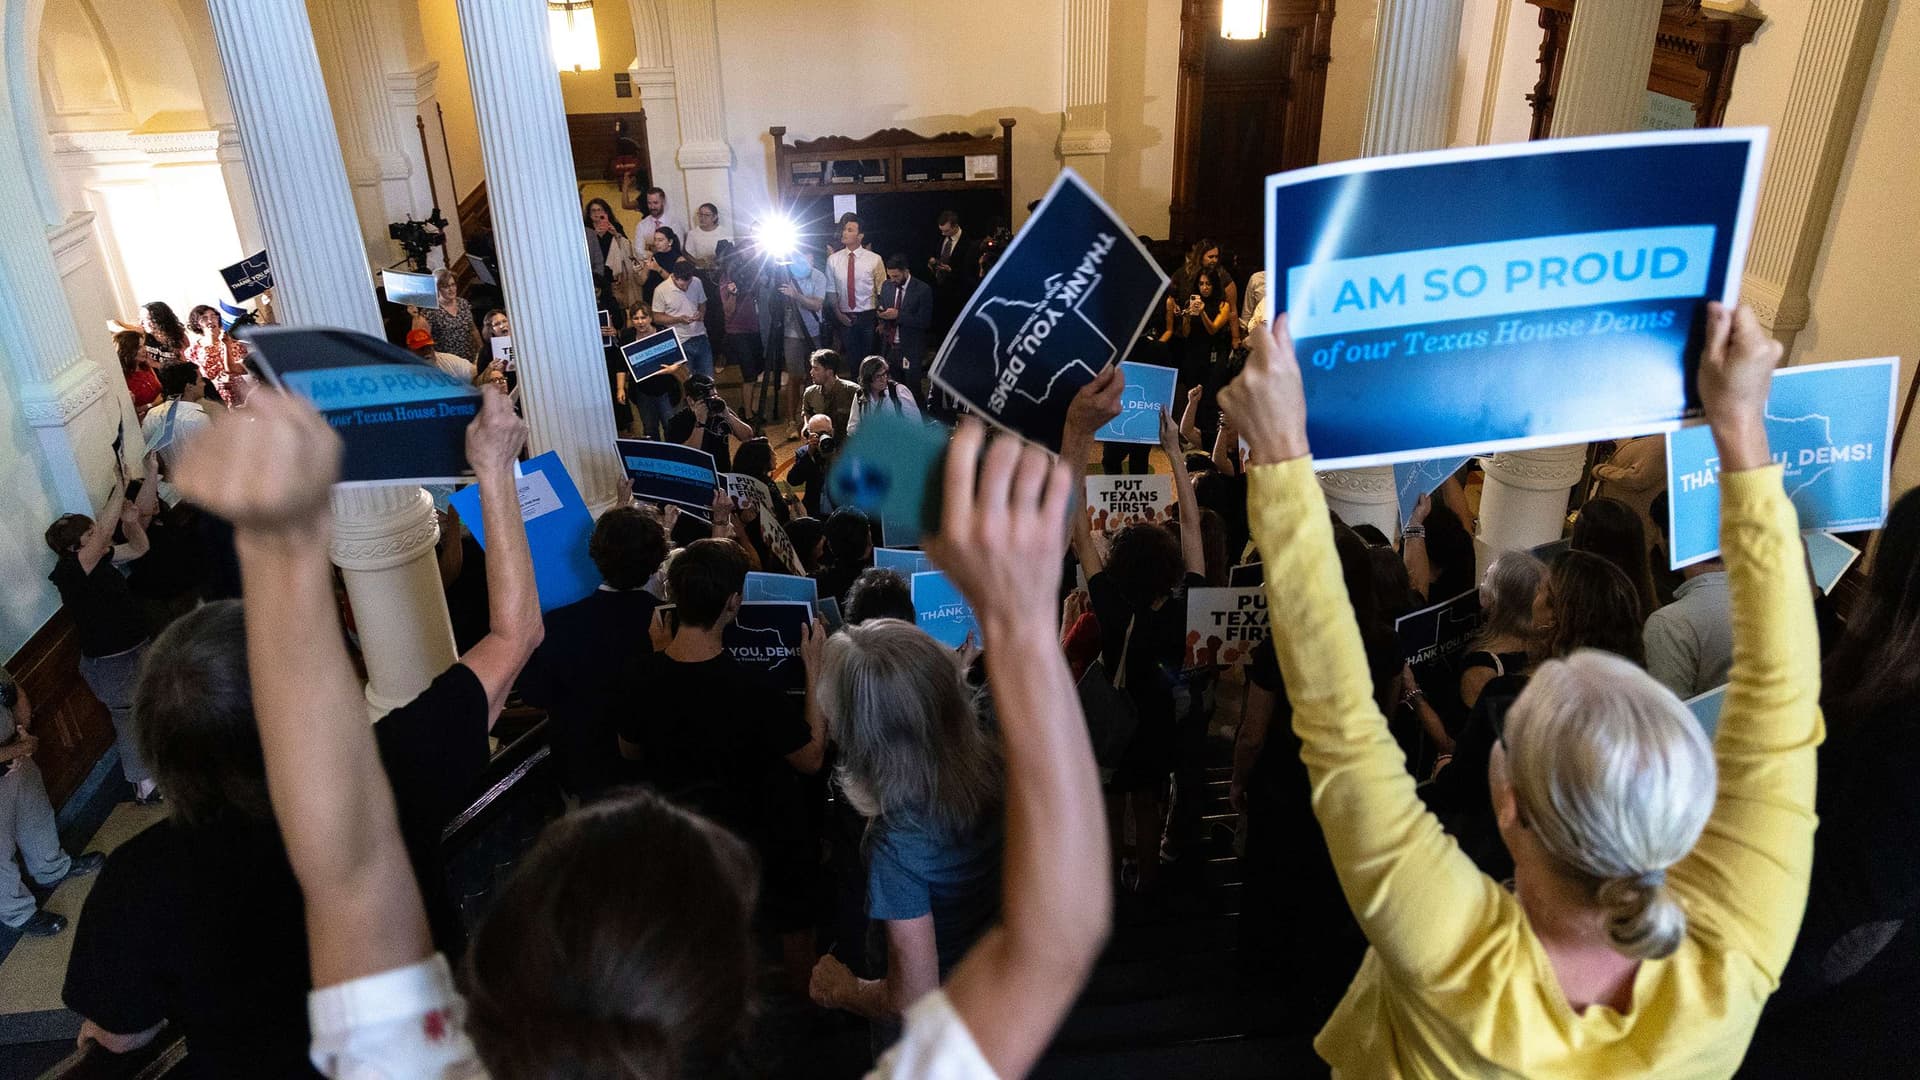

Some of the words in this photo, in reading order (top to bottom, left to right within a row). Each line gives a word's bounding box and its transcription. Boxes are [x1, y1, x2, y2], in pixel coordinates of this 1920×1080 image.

[1056, 232, 1117, 307] THANK
[1332, 273, 1407, 314] AM
[1423, 264, 1488, 302] SO
[1505, 245, 1690, 294] PROUD
[1017, 307, 1065, 355] YOU,
[1311, 338, 1345, 371] of
[1345, 341, 1397, 363] our
[1404, 327, 1488, 357] Texas
[1495, 315, 1584, 346] House
[1590, 308, 1677, 335] Dems
[311, 378, 343, 399] AM
[350, 375, 379, 396] SO
[987, 356, 1027, 416] DEMS!
[354, 410, 394, 426] Texas
[394, 405, 437, 423] House
[438, 402, 476, 418] Dems
[1128, 401, 1161, 411] DEMS
[1680, 467, 1720, 492] THA
[1799, 443, 1873, 466] DEMS!
[1114, 480, 1143, 491] PUT
[1100, 491, 1158, 502] TEXANS
[1110, 502, 1150, 513] FIRST
[1238, 595, 1268, 610] PU
[920, 606, 963, 620] THANK
[1210, 611, 1270, 626] TEXA
[1226, 627, 1272, 641] FIRS
[729, 647, 763, 657] YOU,
[766, 647, 802, 657] DEMS
[1405, 648, 1437, 665] HANK
